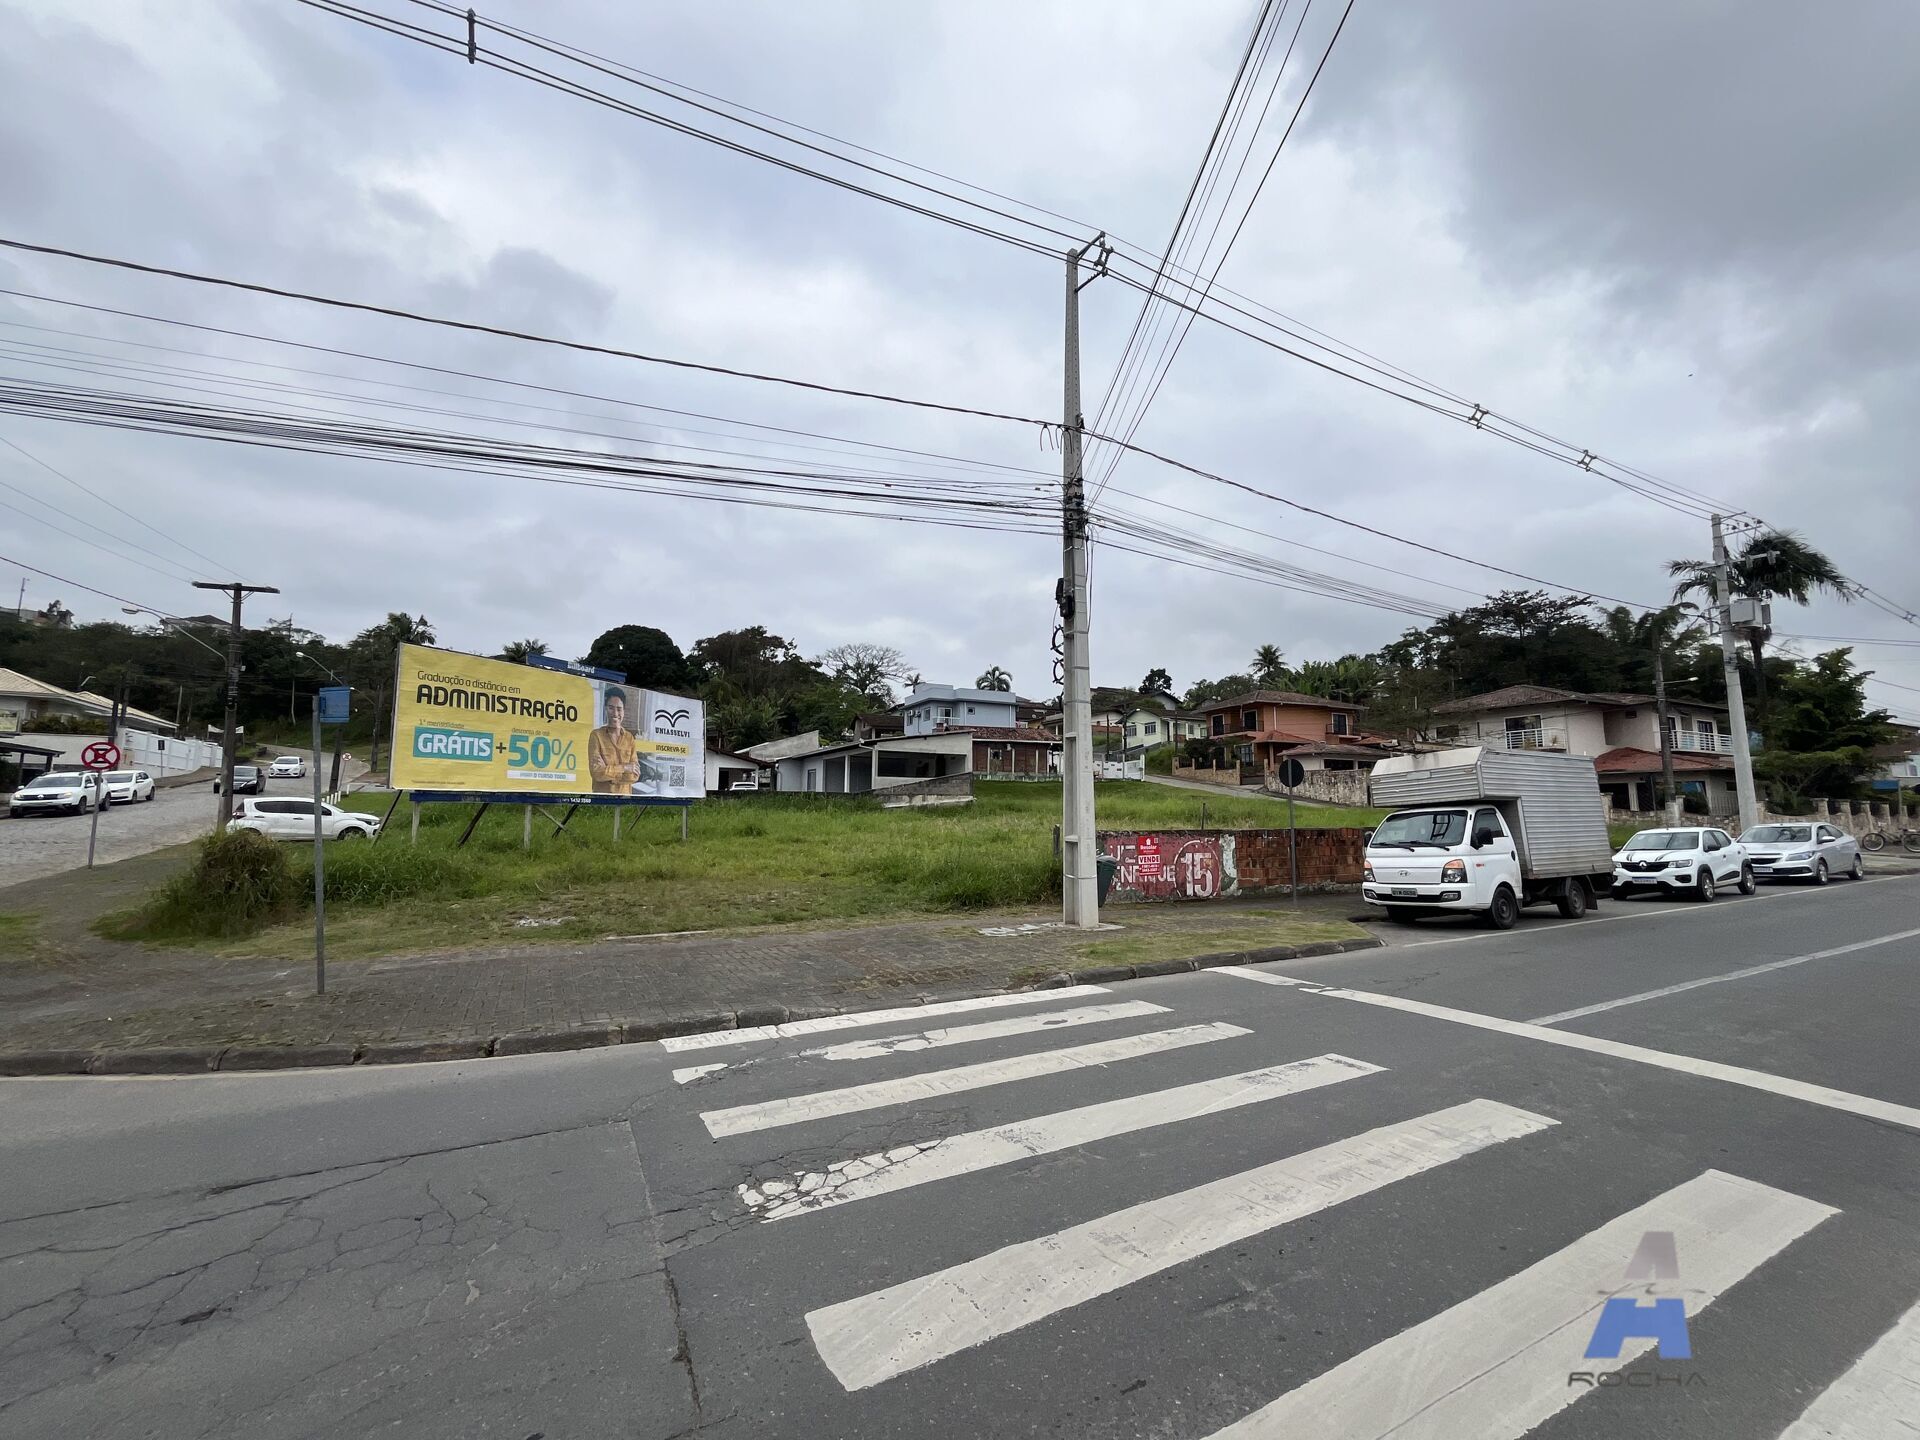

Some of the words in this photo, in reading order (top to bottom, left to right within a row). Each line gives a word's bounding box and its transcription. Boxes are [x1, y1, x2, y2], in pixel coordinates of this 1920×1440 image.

[417, 670, 464, 686] Graduação
[465, 679, 471, 687] a
[472, 679, 507, 693] distância
[508, 686, 521, 694] em
[416, 684, 578, 723] ADMINISTRAÇÃO
[417, 731, 491, 757] GRÁTIS
[655, 727, 690, 738] UNIASSELVI
[1139, 855, 1159, 863] VENDE
[1181, 852, 1213, 897] 15
